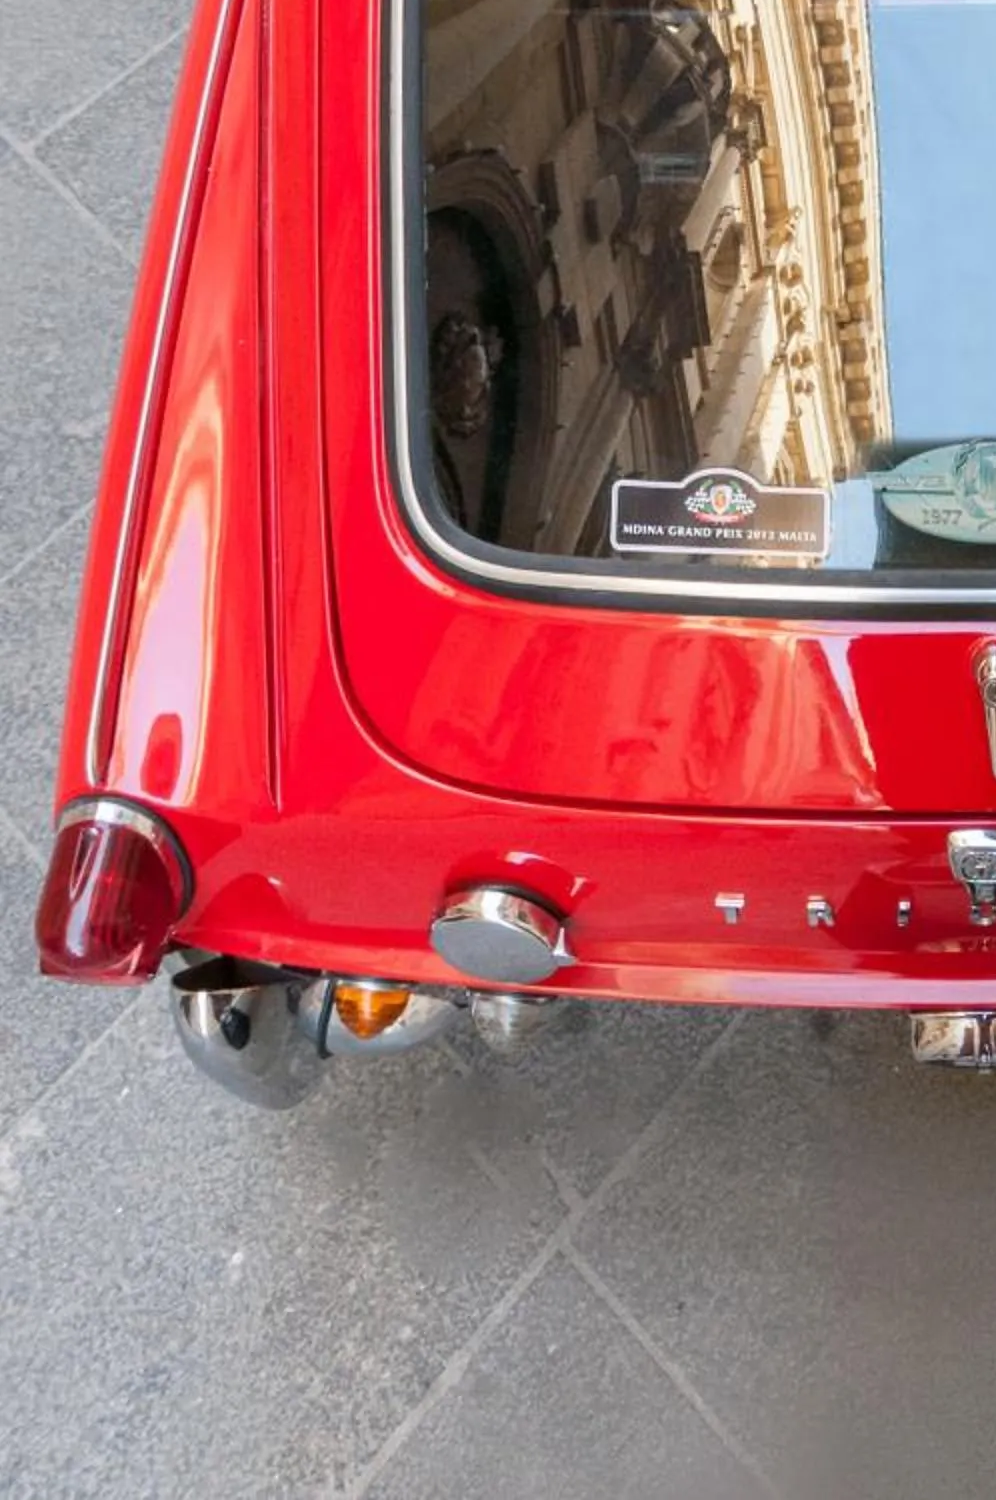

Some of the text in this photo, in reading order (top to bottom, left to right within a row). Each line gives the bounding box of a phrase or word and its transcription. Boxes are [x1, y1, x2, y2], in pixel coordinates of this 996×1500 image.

[921, 508, 964, 526] 1977
[622, 523, 665, 536] MDINA
[668, 525, 712, 538] GRAND
[715, 527, 743, 539] PRIX
[779, 530, 817, 543] MALTA
